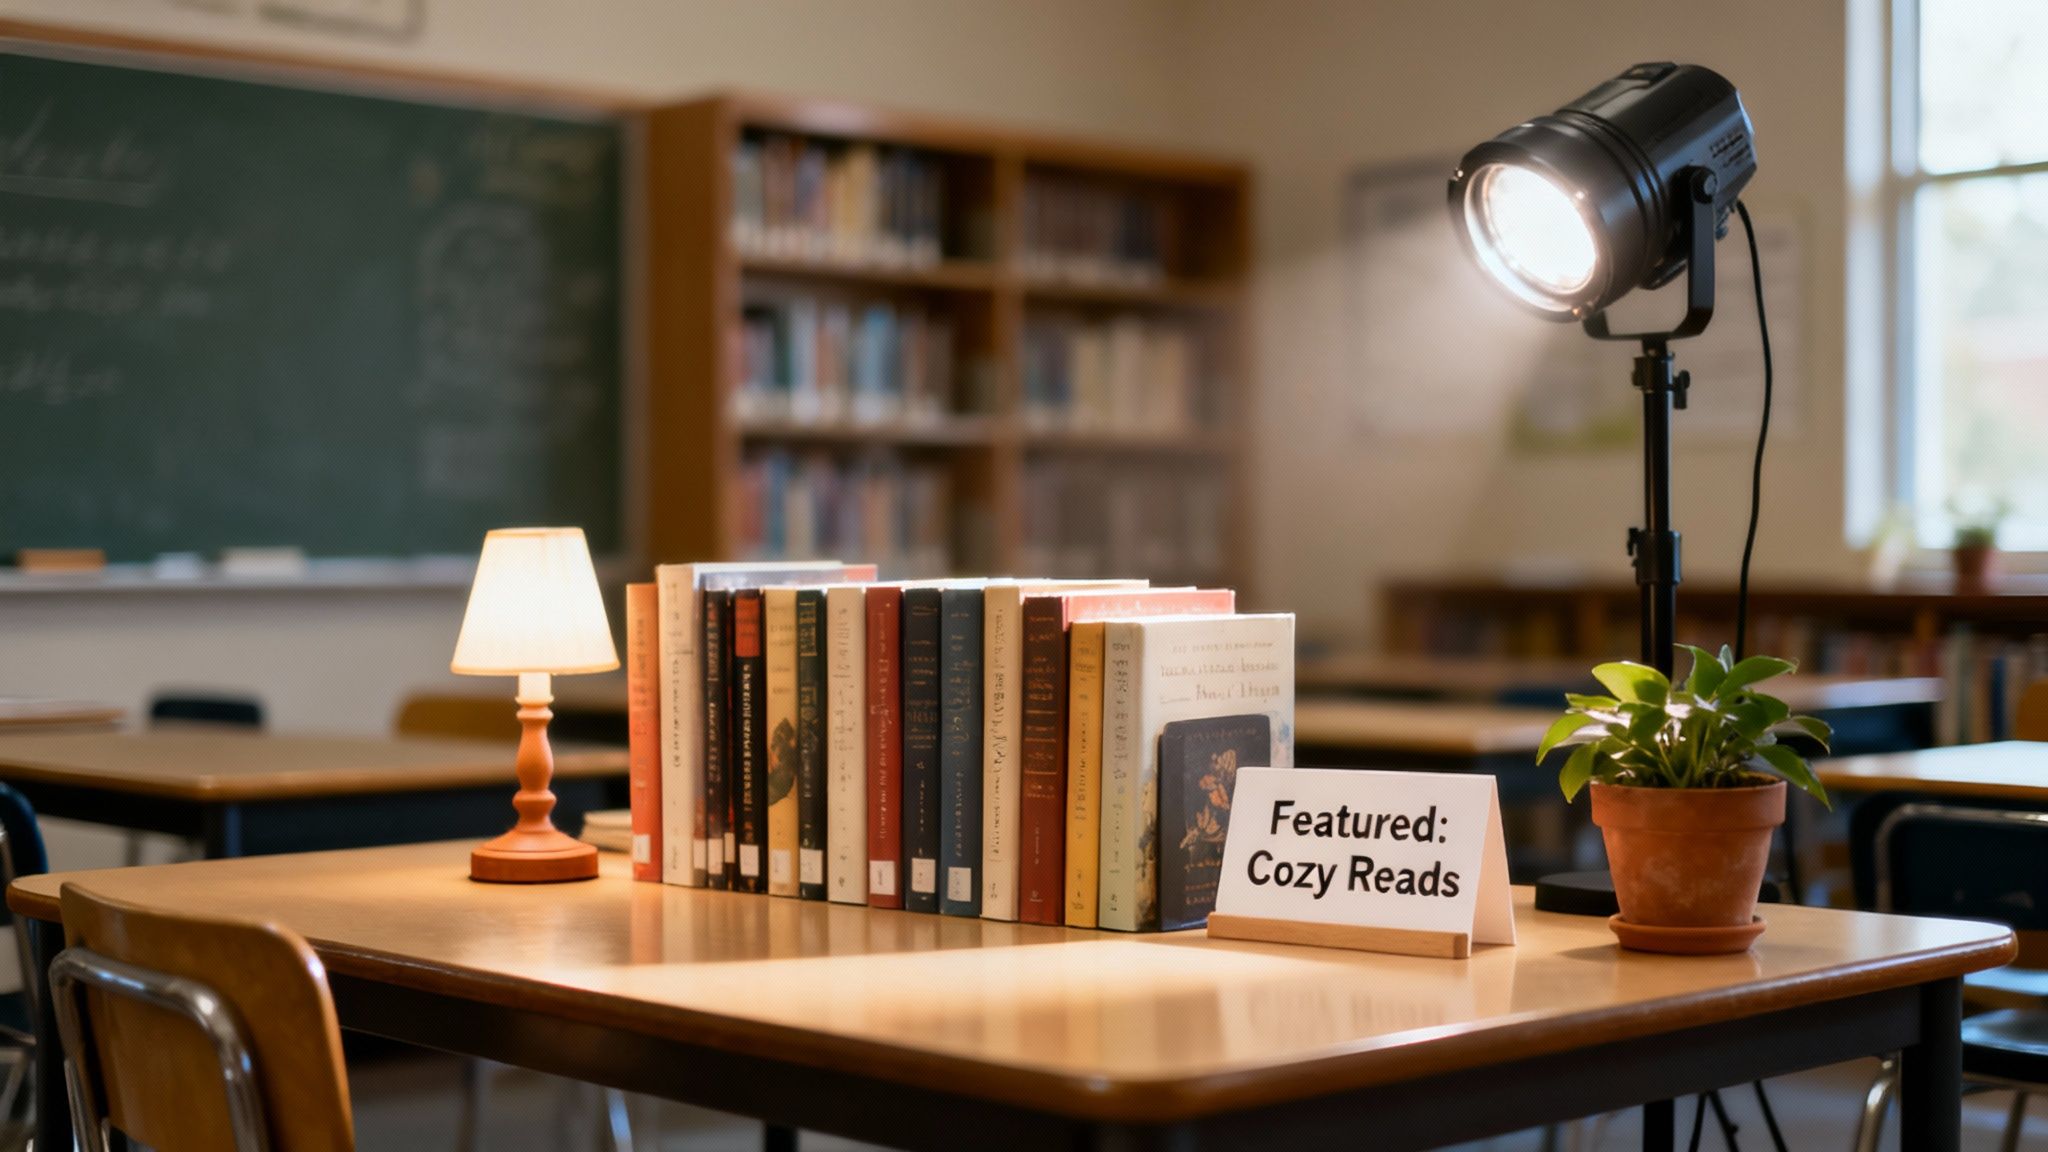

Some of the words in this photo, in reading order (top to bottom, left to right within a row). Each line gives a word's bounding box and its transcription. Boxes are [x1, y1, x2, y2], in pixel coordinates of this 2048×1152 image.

[1270, 800, 1448, 844] Featured:
[1247, 850, 1338, 900] Cozy
[1347, 855, 1460, 898] Reads
